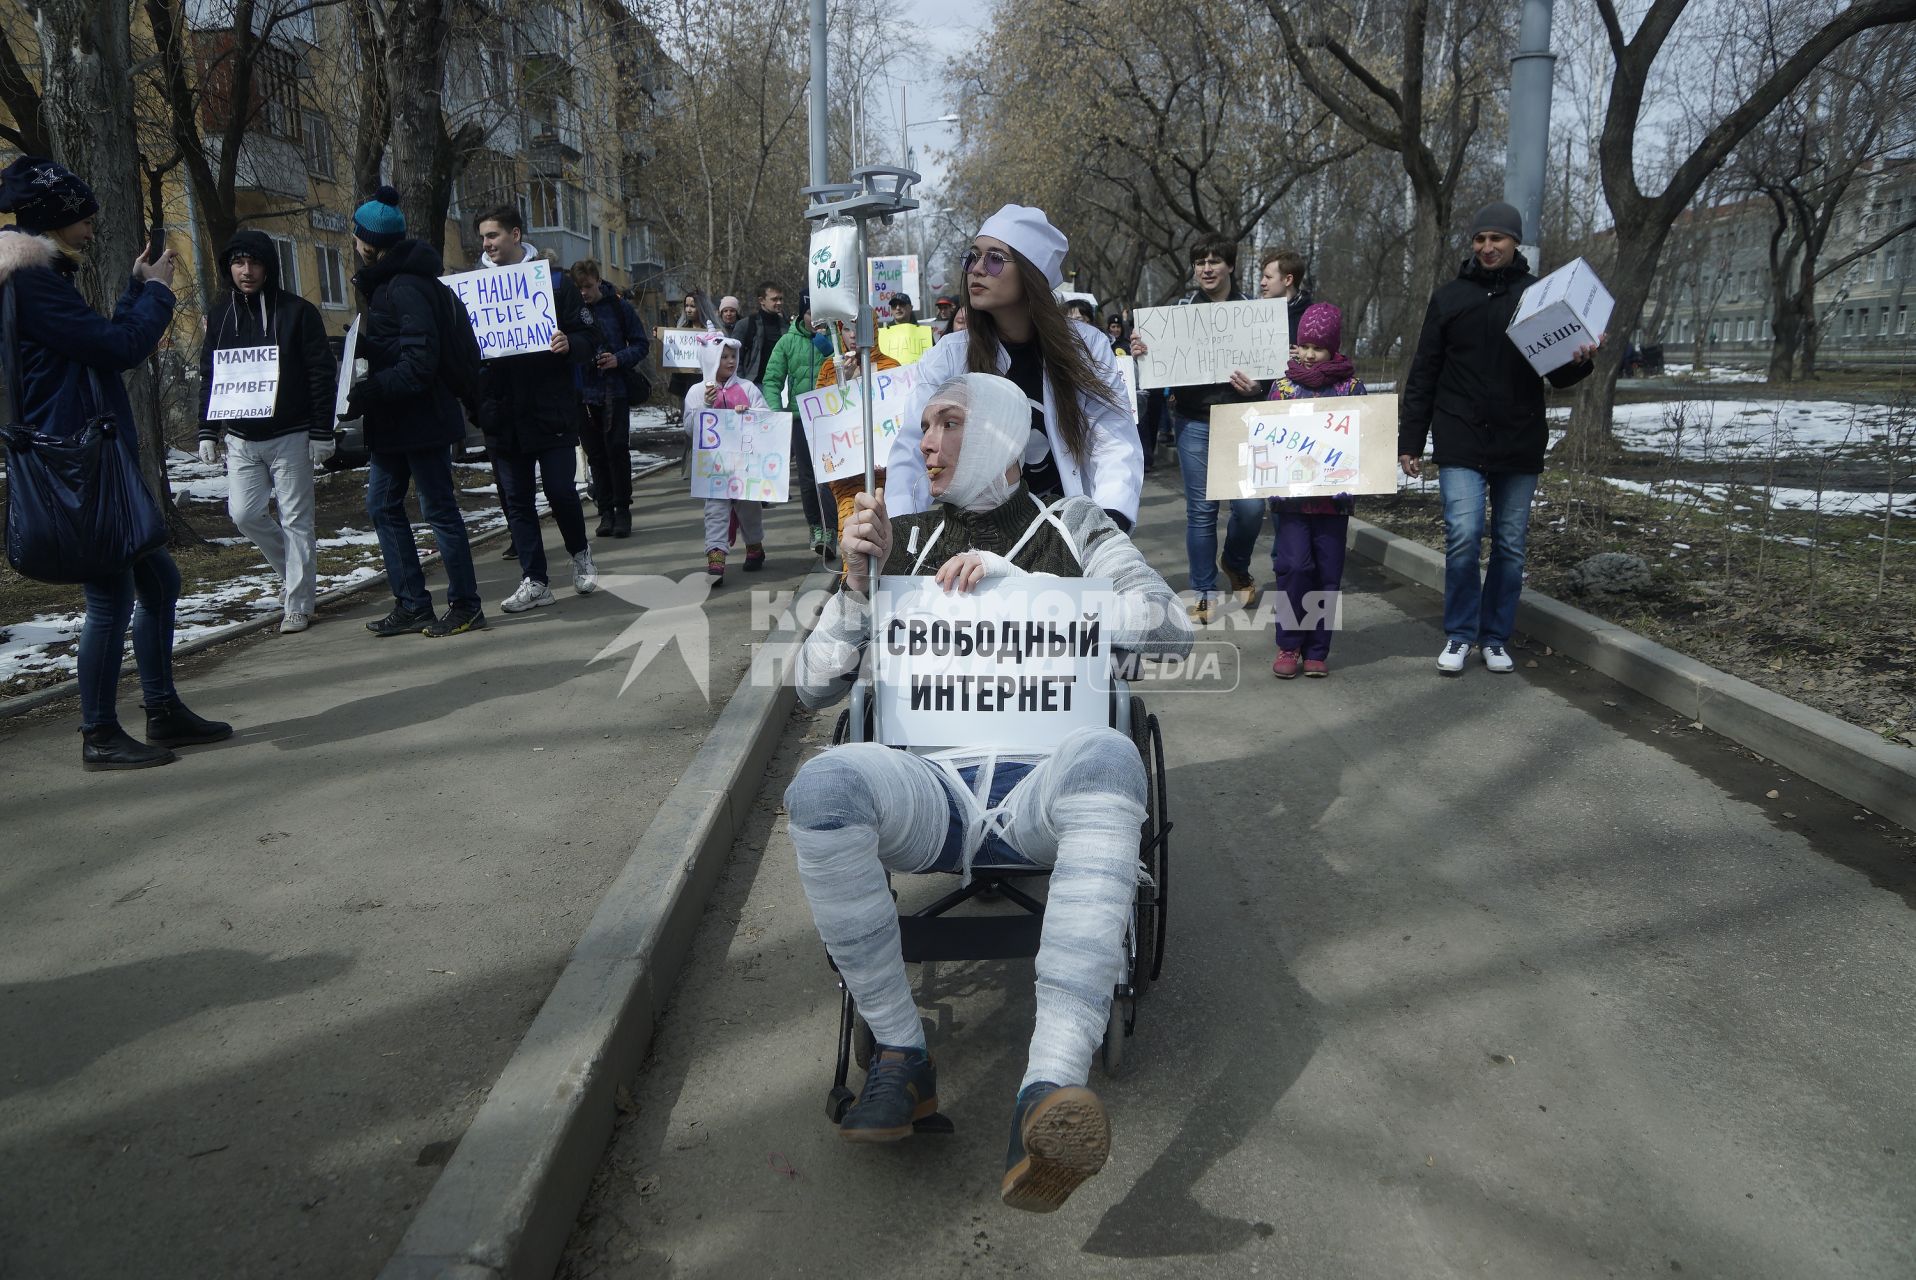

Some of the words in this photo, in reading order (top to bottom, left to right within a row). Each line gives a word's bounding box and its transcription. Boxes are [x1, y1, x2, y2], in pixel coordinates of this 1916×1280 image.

[477, 272, 529, 304] НАШИ
[875, 282, 886, 291] ВО
[878, 270, 901, 280] МИР
[470, 304, 526, 328] ЯТЫЕ
[1137, 306, 1229, 341] КУПЛЮ
[1233, 305, 1274, 329] РОДИ
[478, 321, 553, 359] РОПАДАЛИ
[1525, 322, 1582, 358] ДАЁШЬ
[217, 348, 277, 365] МАМКЕ
[213, 380, 277, 395] ПРИВЕТ
[209, 405, 272, 419] ПЕРЕДАВАЙ
[1323, 413, 1351, 435] ЗА
[831, 415, 901, 455] МЕЯ!
[887, 612, 1100, 664] СВОБОДНЫЙ
[911, 674, 1077, 712] ИНТЕРНЕТ
